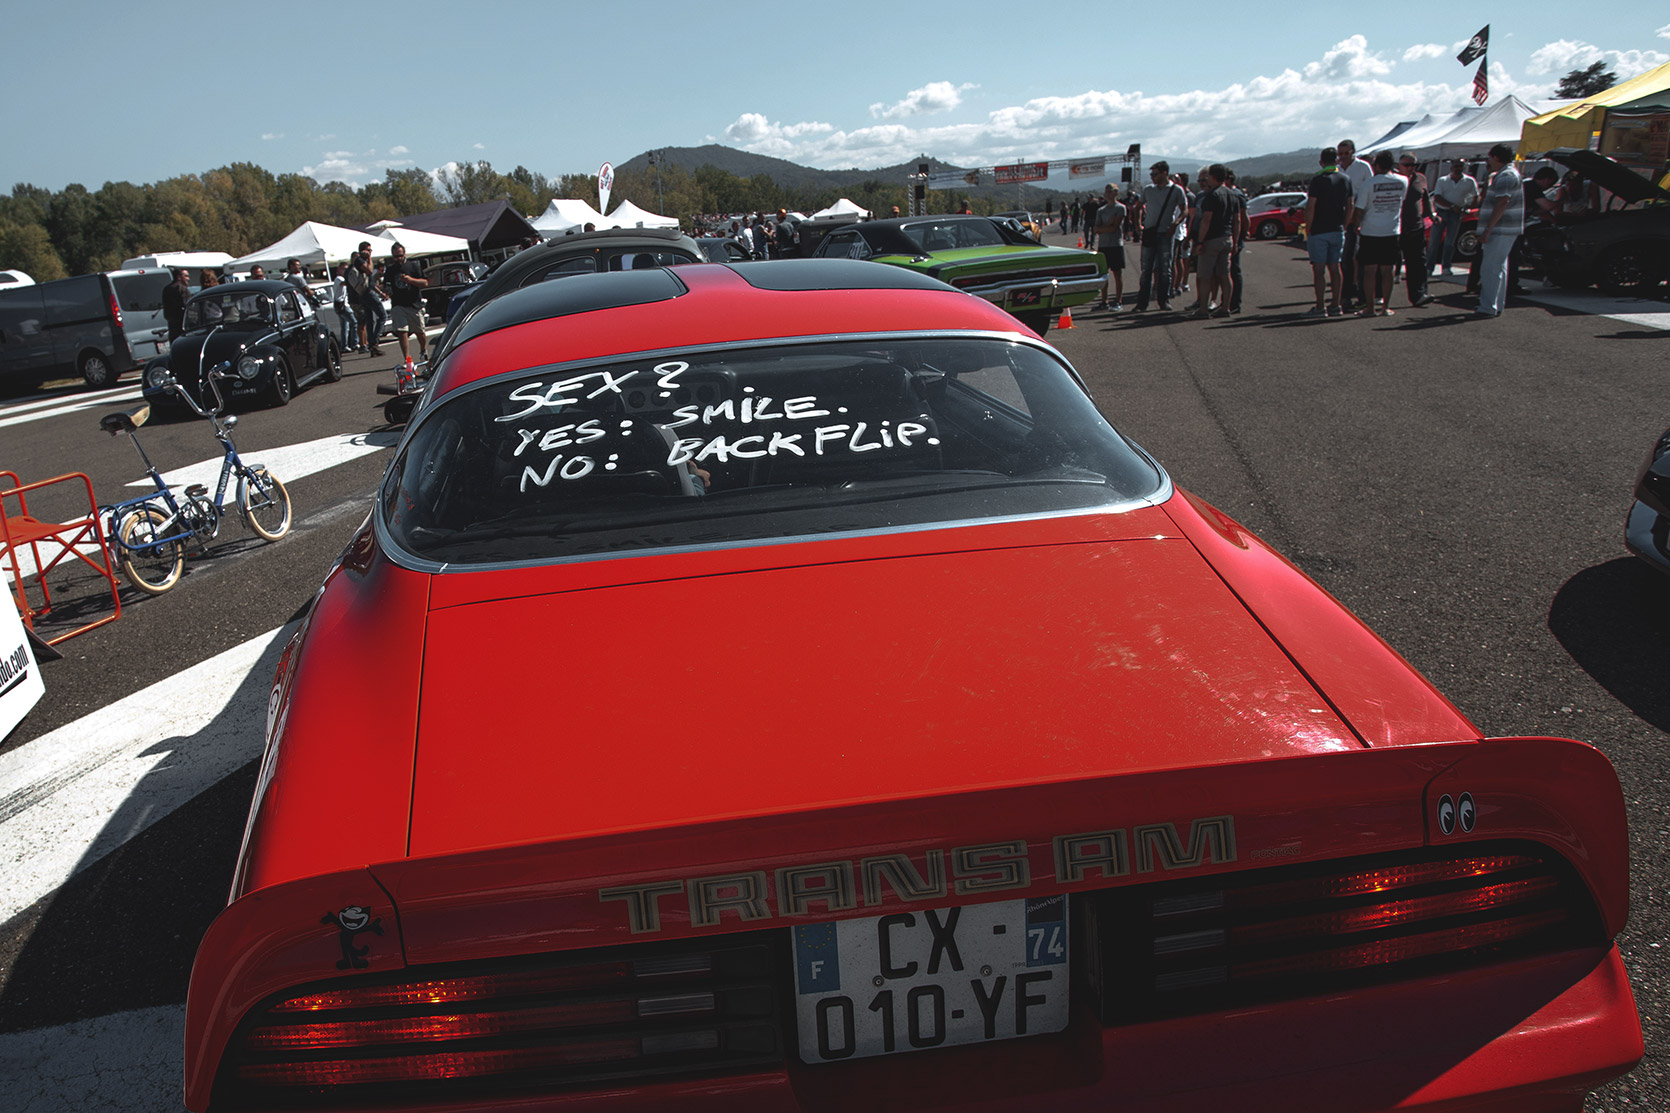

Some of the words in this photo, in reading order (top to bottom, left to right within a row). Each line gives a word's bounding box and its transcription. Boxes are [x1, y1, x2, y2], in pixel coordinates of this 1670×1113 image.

[1251, 845, 1302, 860] PONTIAC
[600, 839, 1032, 935] TRANS
[1051, 815, 1239, 885] AM
[1027, 926, 1065, 960] 74
[811, 960, 825, 980] F
[816, 969, 1054, 1061] 010-YF
